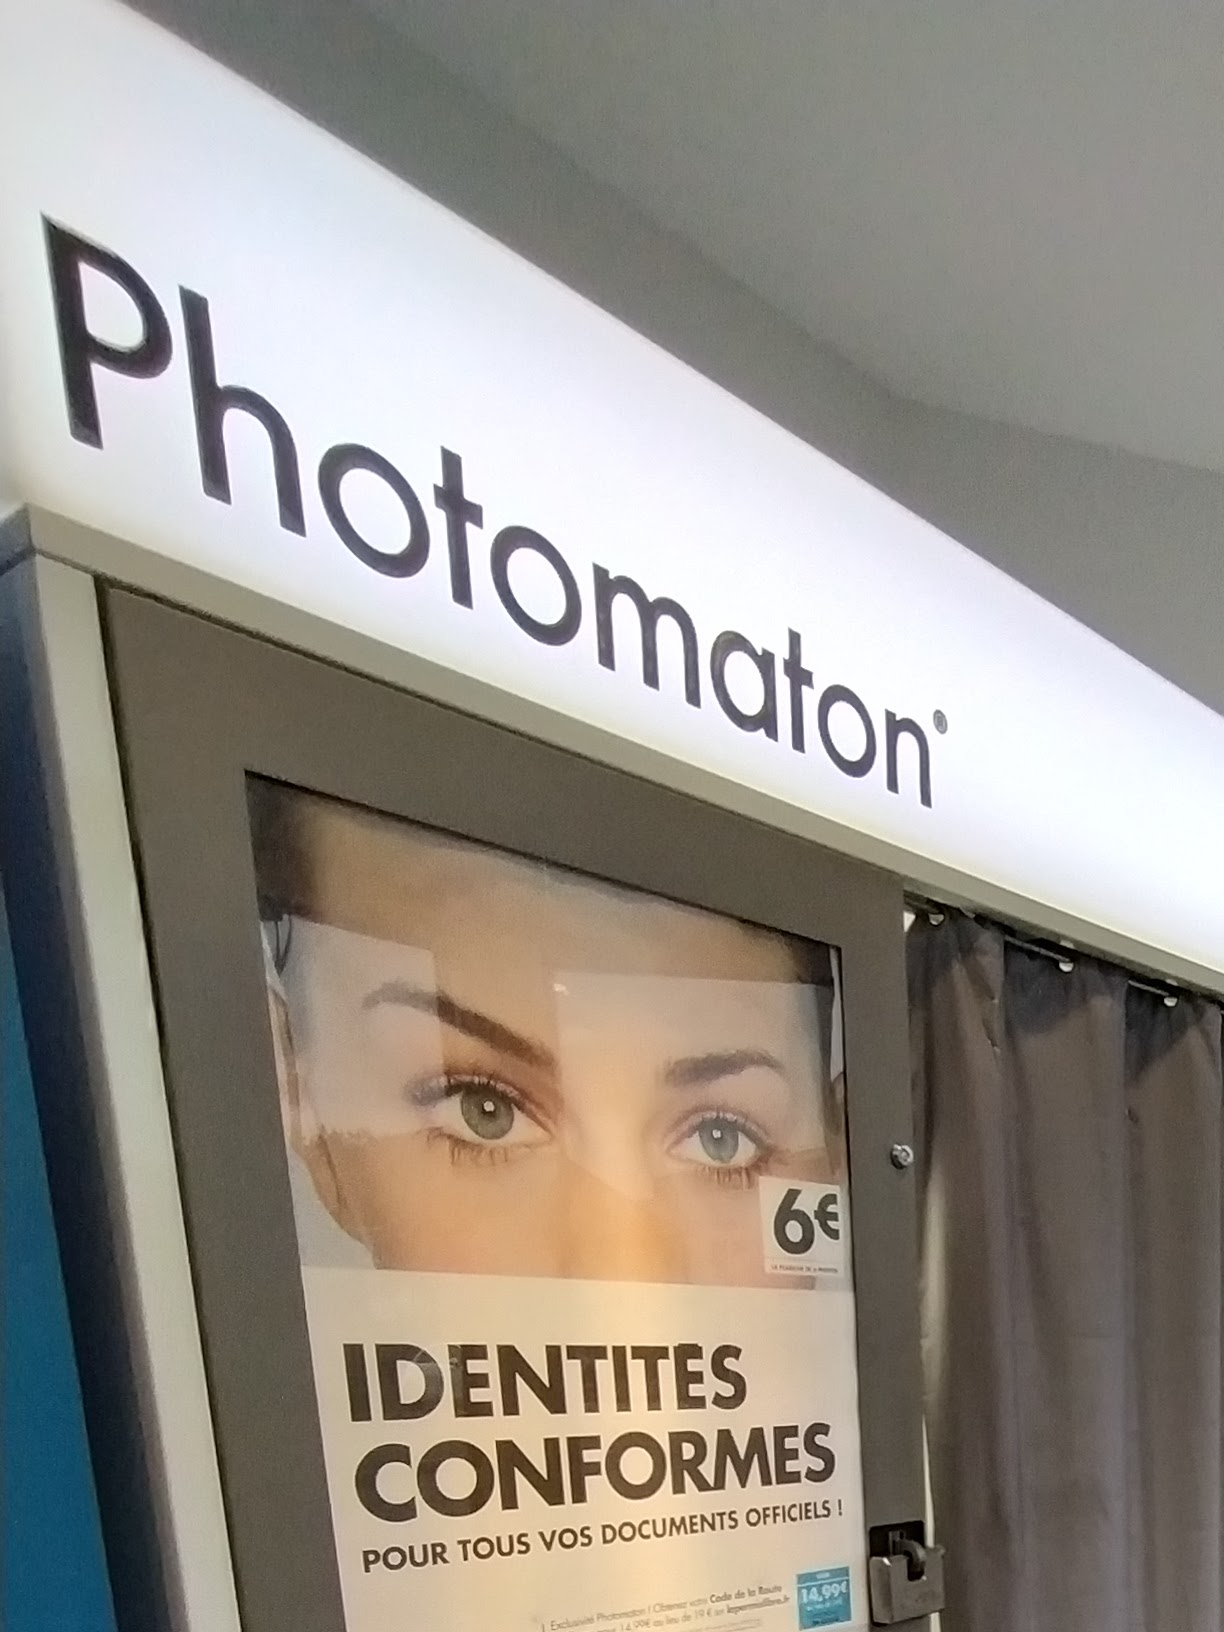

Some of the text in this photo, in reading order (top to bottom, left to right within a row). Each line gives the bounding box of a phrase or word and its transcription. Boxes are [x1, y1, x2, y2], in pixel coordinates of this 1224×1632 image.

[773, 1188, 840, 1255] 6€
[355, 1422, 836, 1523] CONFORMES
[362, 1543, 449, 1573] POUR
[457, 1531, 530, 1562] TOUS
[538, 1525, 593, 1552] VOS
[601, 1510, 739, 1545] DOCUMENTS
[745, 1501, 831, 1528] OFFICIELS
[681, 1611, 692, 1622] de
[709, 1591, 732, 1604] Code
[734, 1589, 746, 1600] de
[748, 1588, 756, 1598] la
